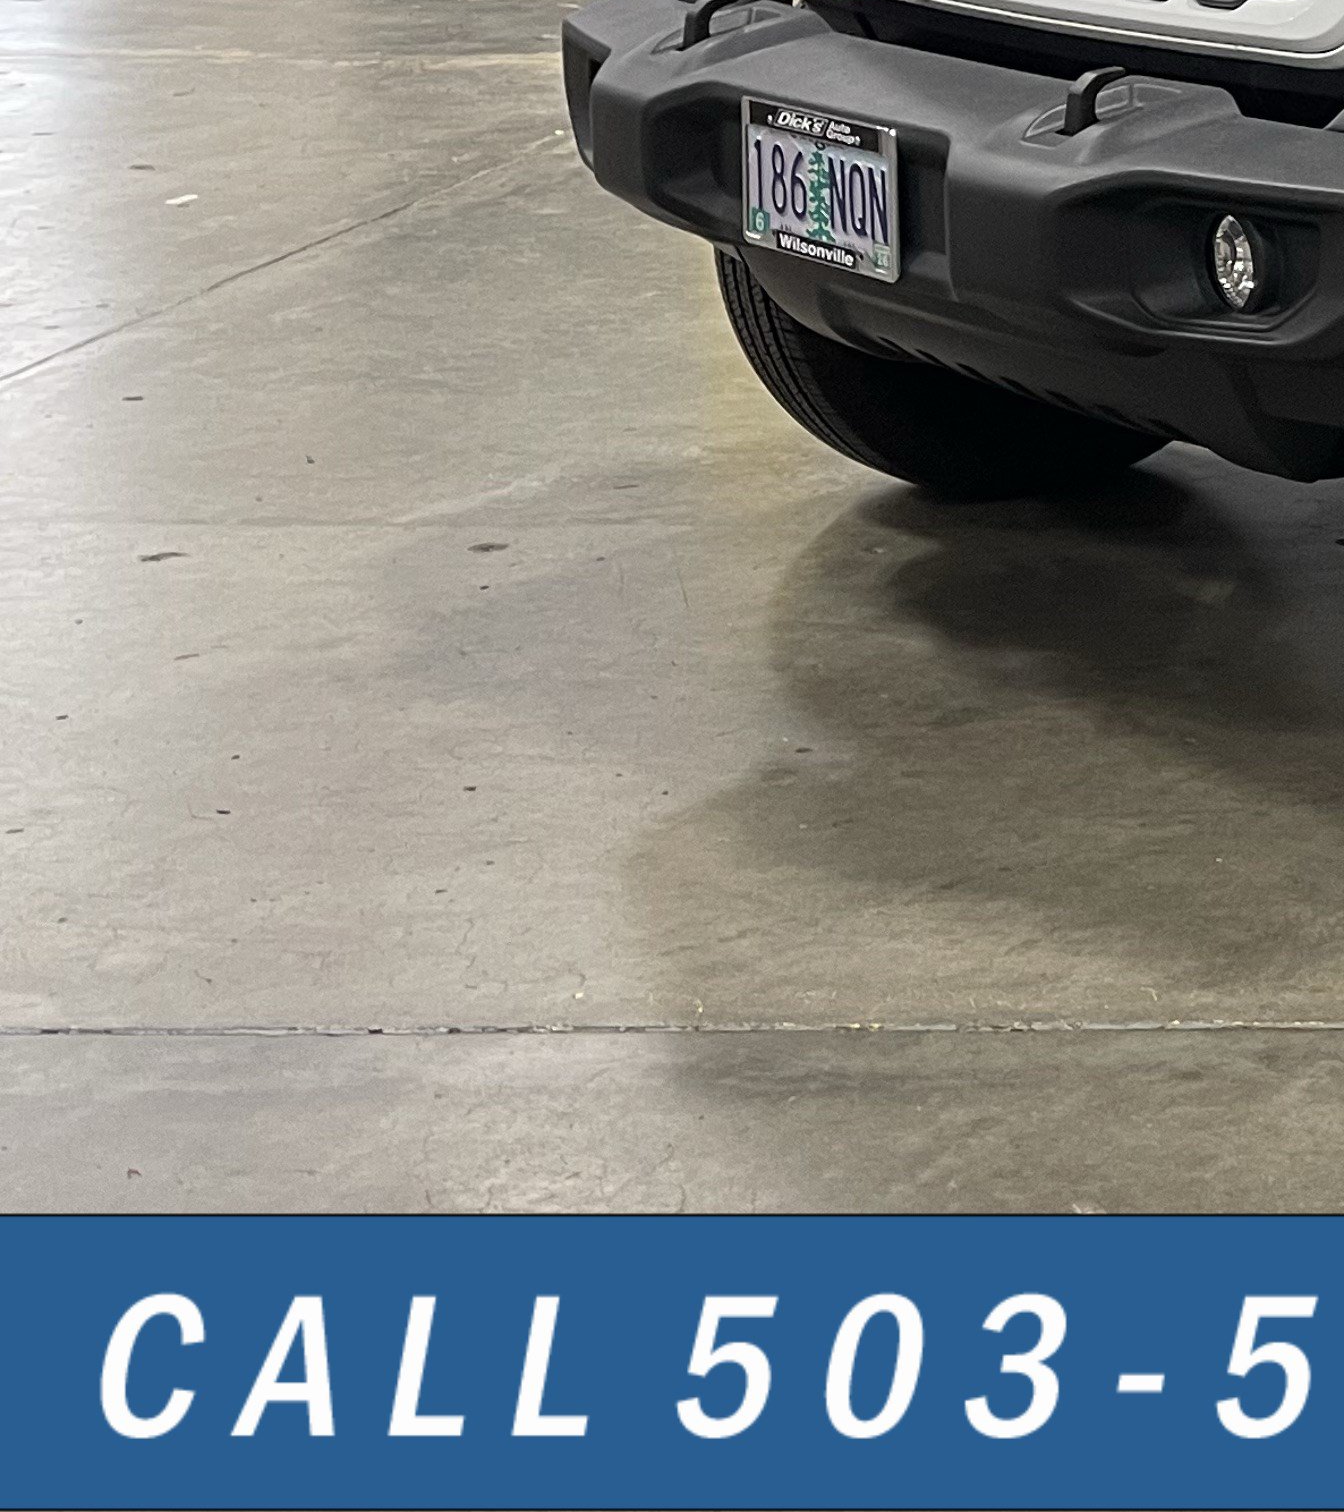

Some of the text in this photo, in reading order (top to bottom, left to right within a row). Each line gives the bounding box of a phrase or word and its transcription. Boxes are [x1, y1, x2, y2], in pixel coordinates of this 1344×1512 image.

[777, 111, 825, 134] Dick's
[754, 138, 889, 246] 186 NQN
[779, 232, 854, 266] Wilsonville
